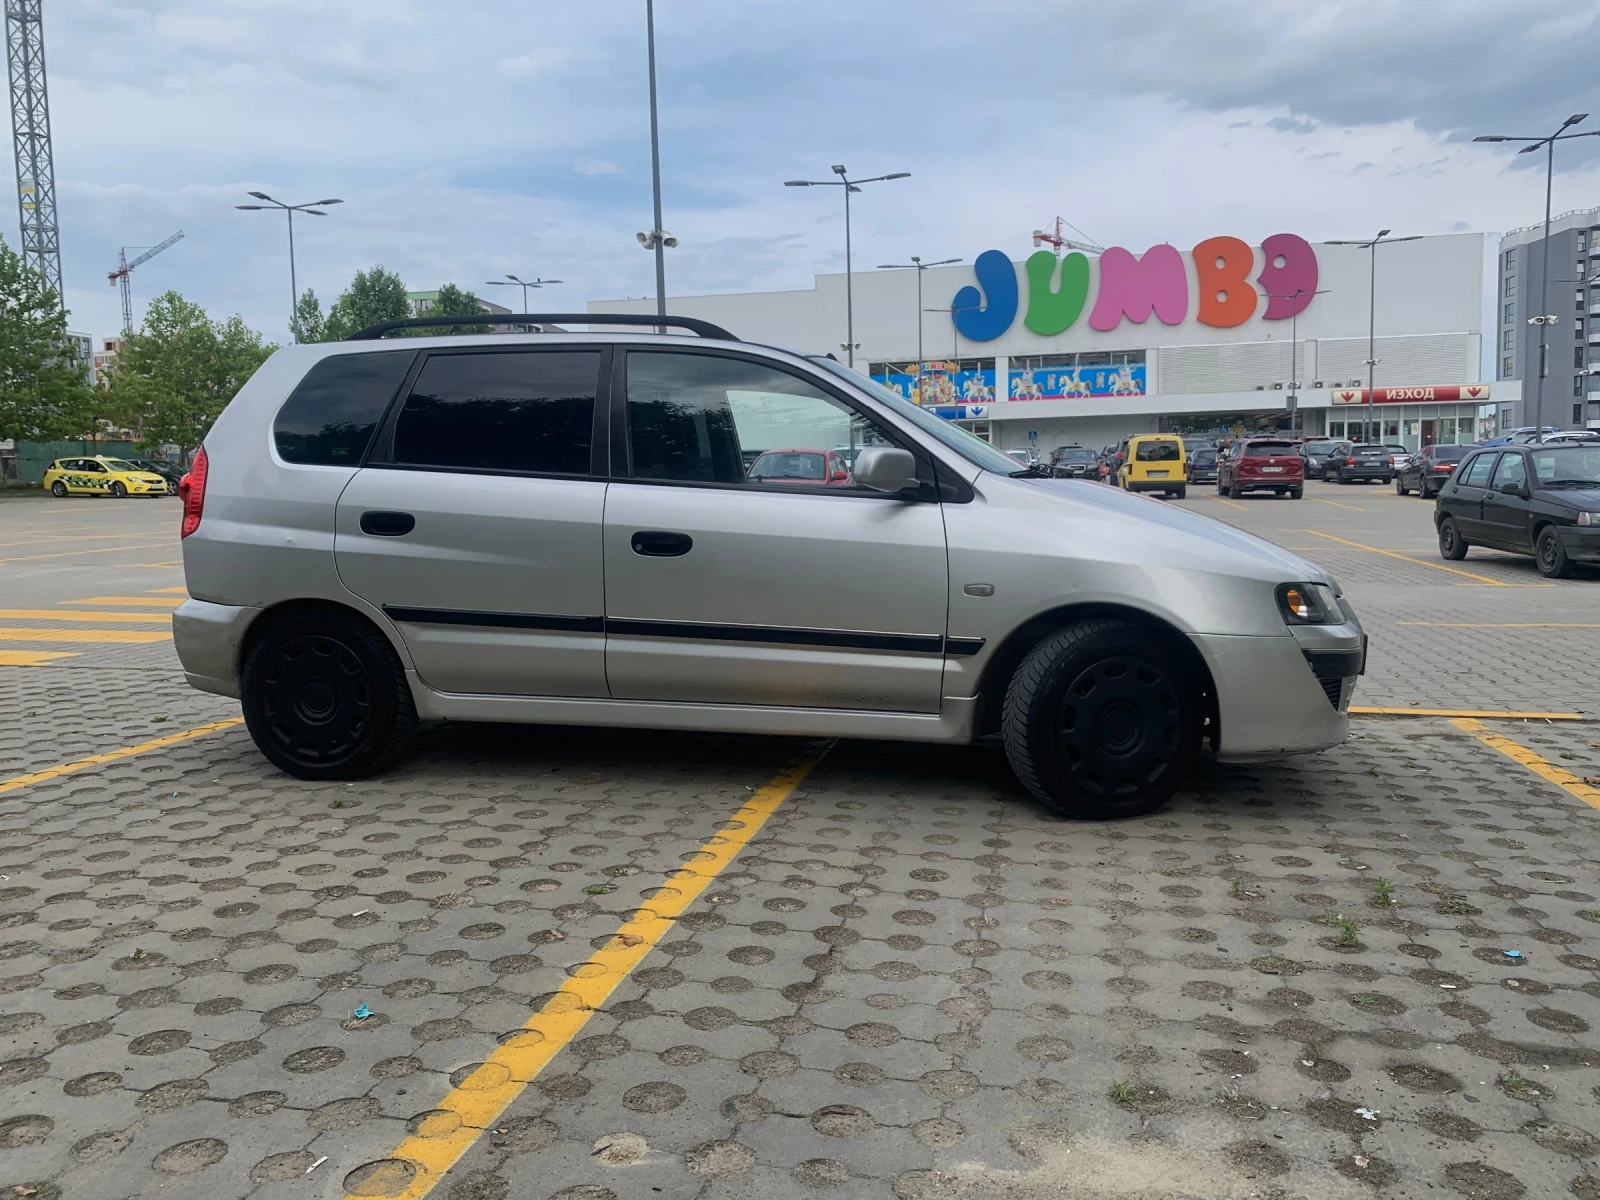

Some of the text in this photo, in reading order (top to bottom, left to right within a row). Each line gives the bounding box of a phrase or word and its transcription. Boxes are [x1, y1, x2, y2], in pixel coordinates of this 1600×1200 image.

[951, 233, 1318, 342] JUMBO
[921, 362, 945, 371] JUMBO
[1386, 387, 1434, 400] ИЗХОД
